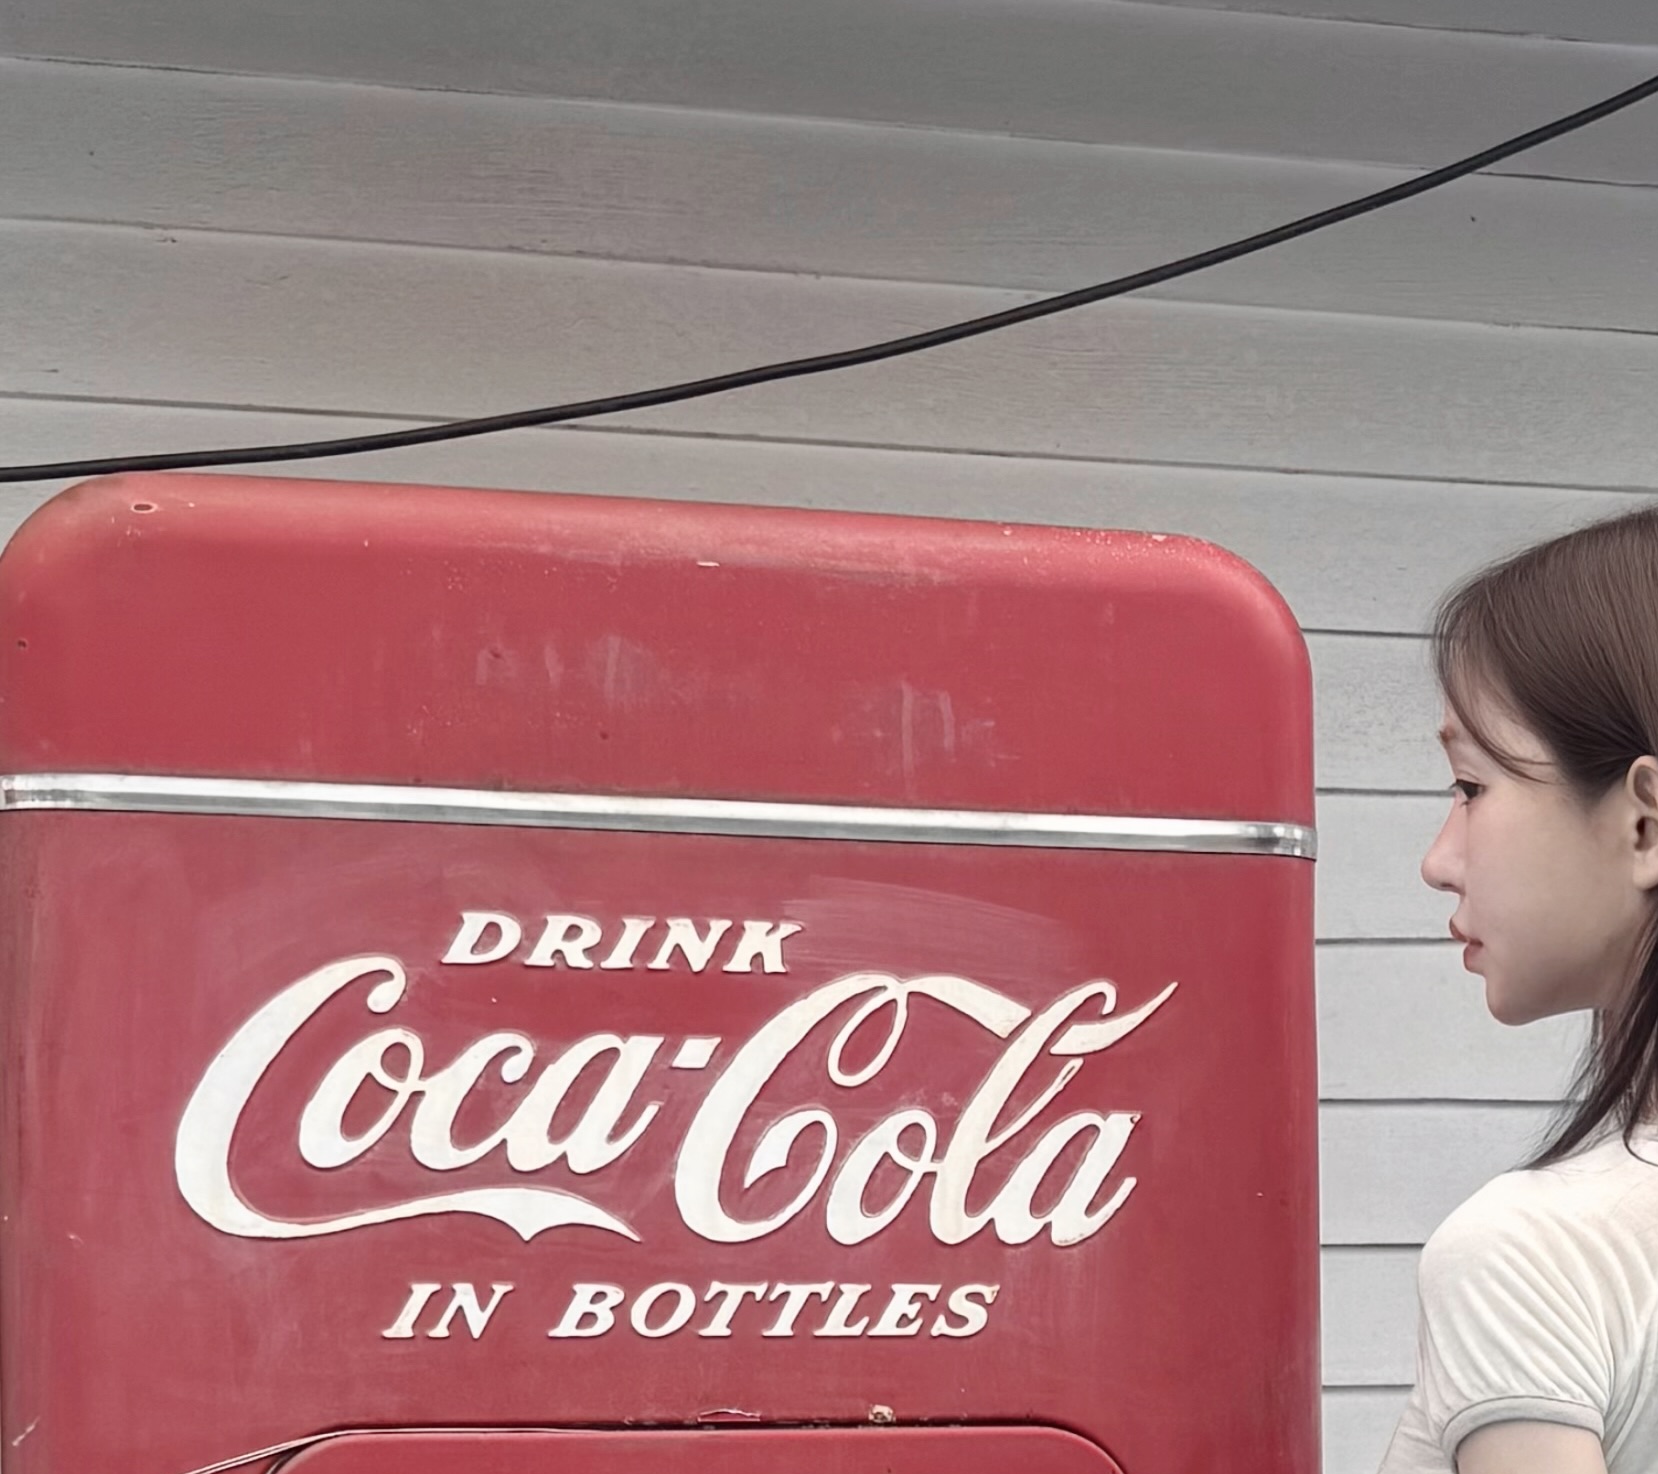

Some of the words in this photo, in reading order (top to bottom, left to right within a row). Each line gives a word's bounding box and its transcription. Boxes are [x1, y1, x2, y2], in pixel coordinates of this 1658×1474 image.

[440, 910, 802, 975] DRINK
[174, 955, 1178, 1247] Coca-Cola
[382, 1281, 512, 1339] IN
[548, 1282, 1000, 1338] BOTTLES
